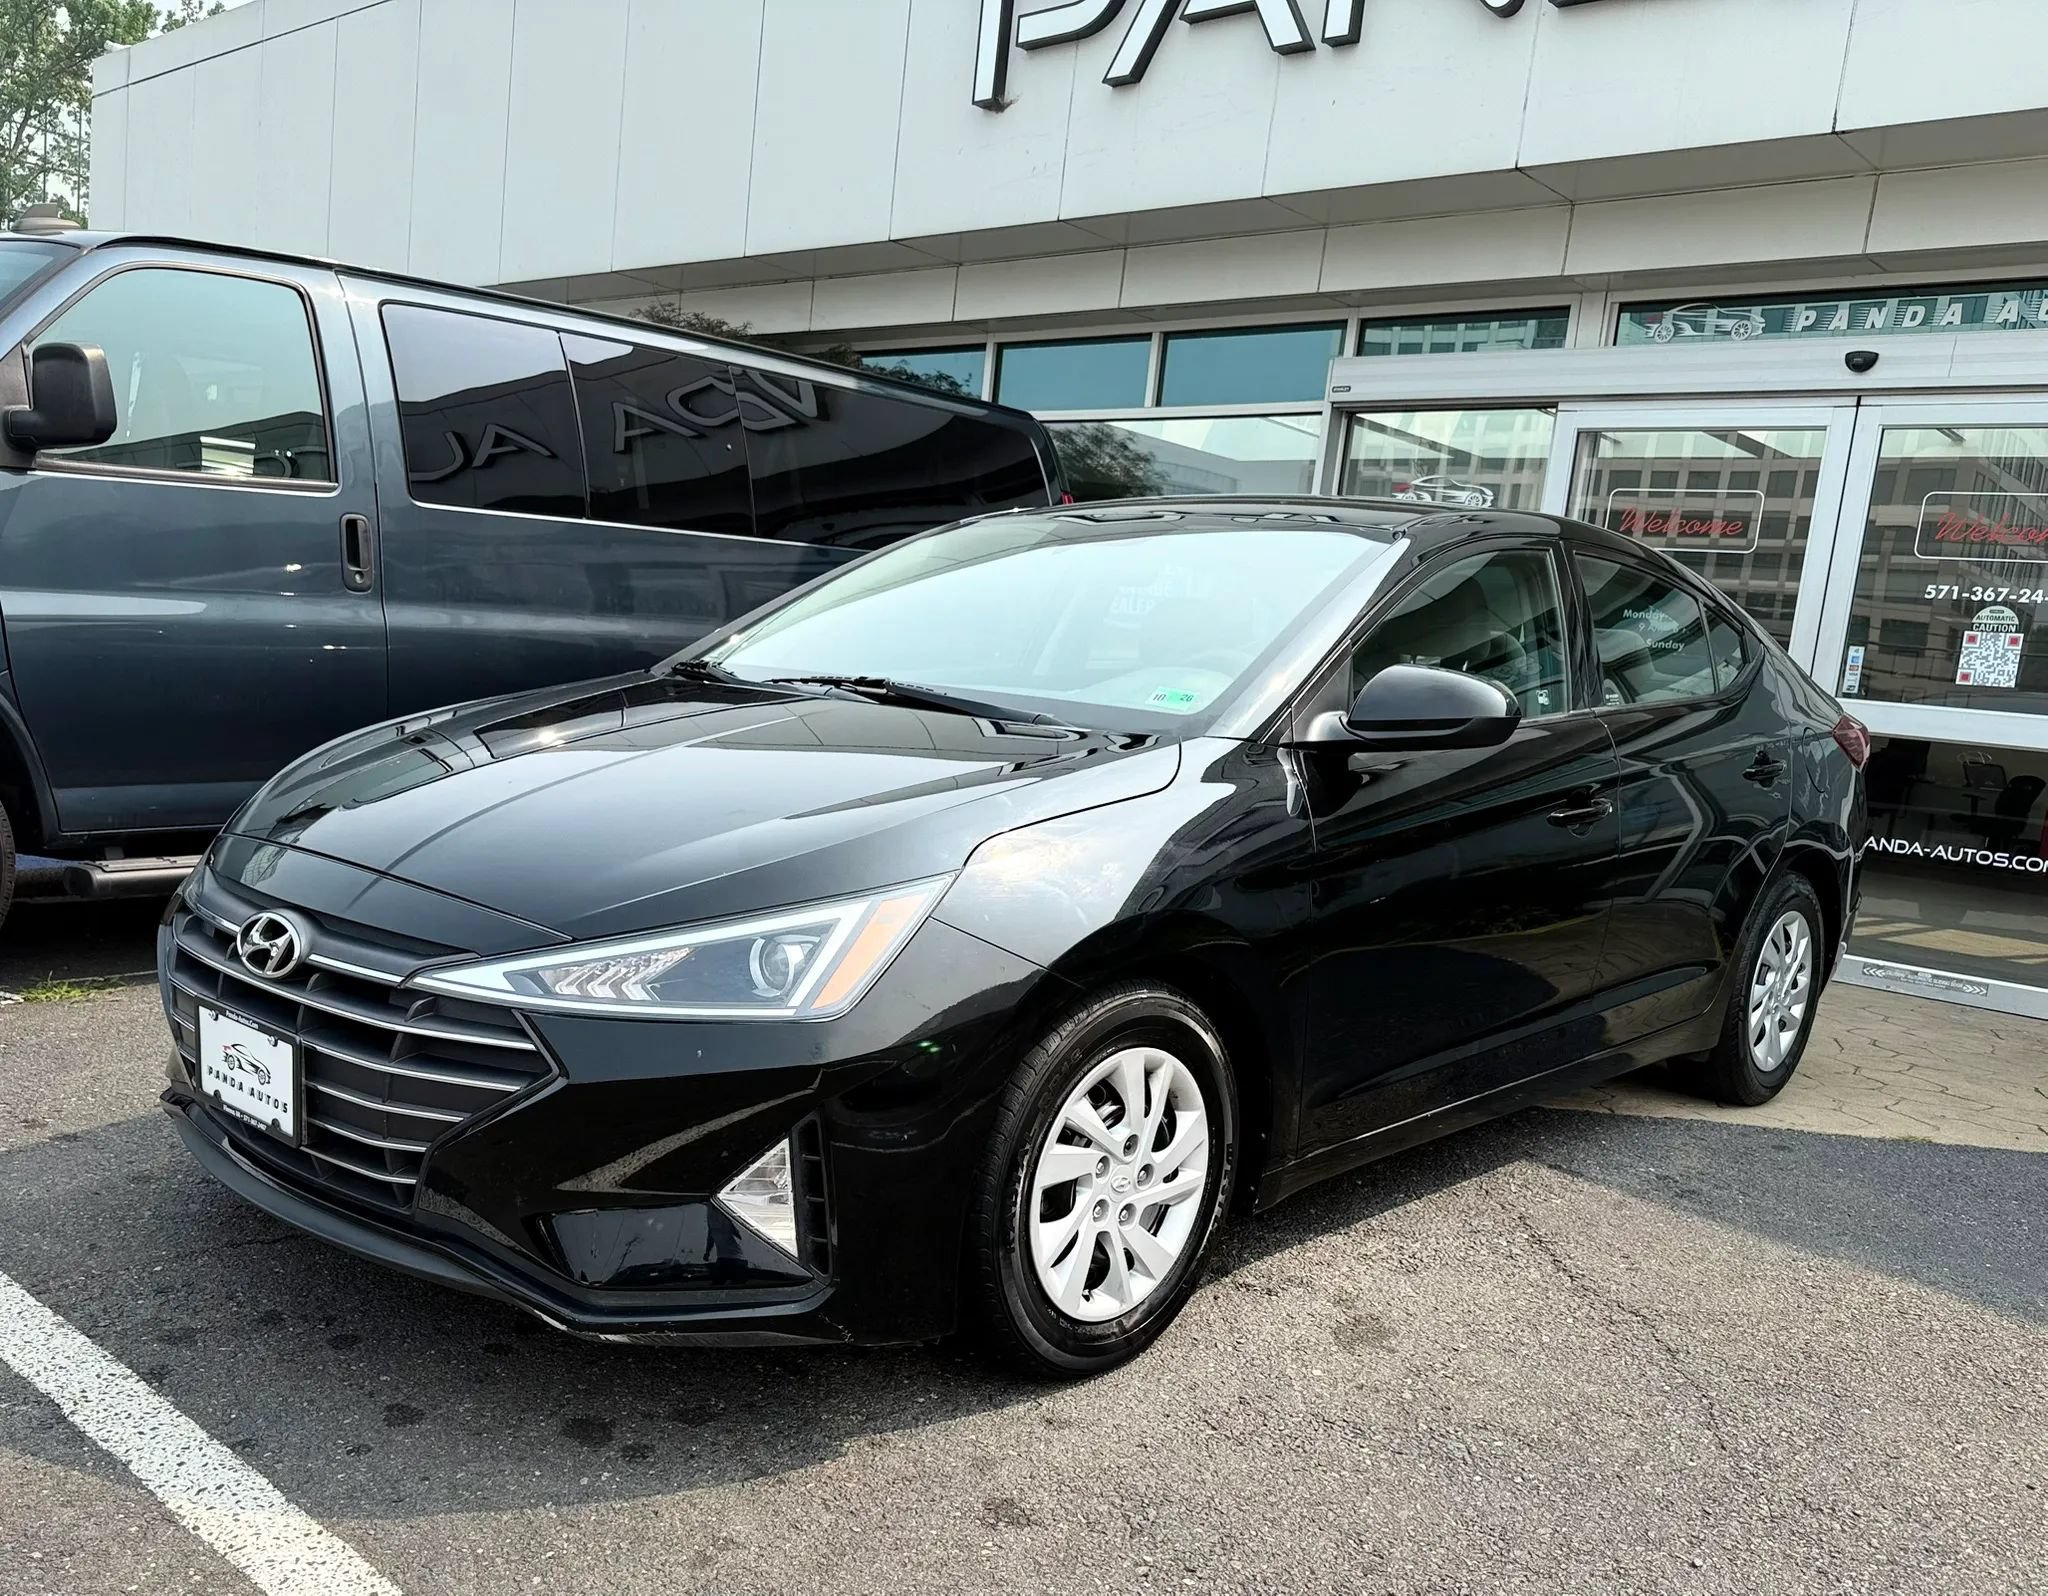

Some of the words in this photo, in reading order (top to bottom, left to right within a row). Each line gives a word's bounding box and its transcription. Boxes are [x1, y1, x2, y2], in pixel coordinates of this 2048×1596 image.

[1795, 303, 1963, 331] PANDA
[1619, 505, 1744, 537] Welcome
[1924, 585, 2048, 604] 571-367-24
[1975, 614, 2016, 623] AUTOMATIC
[1972, 624, 2016, 633] CAUTION
[1646, 638, 1685, 652] Sunday
[1180, 694, 1194, 702] 26
[208, 1064, 244, 1092] PANDA
[248, 1087, 288, 1114] AUTOS
